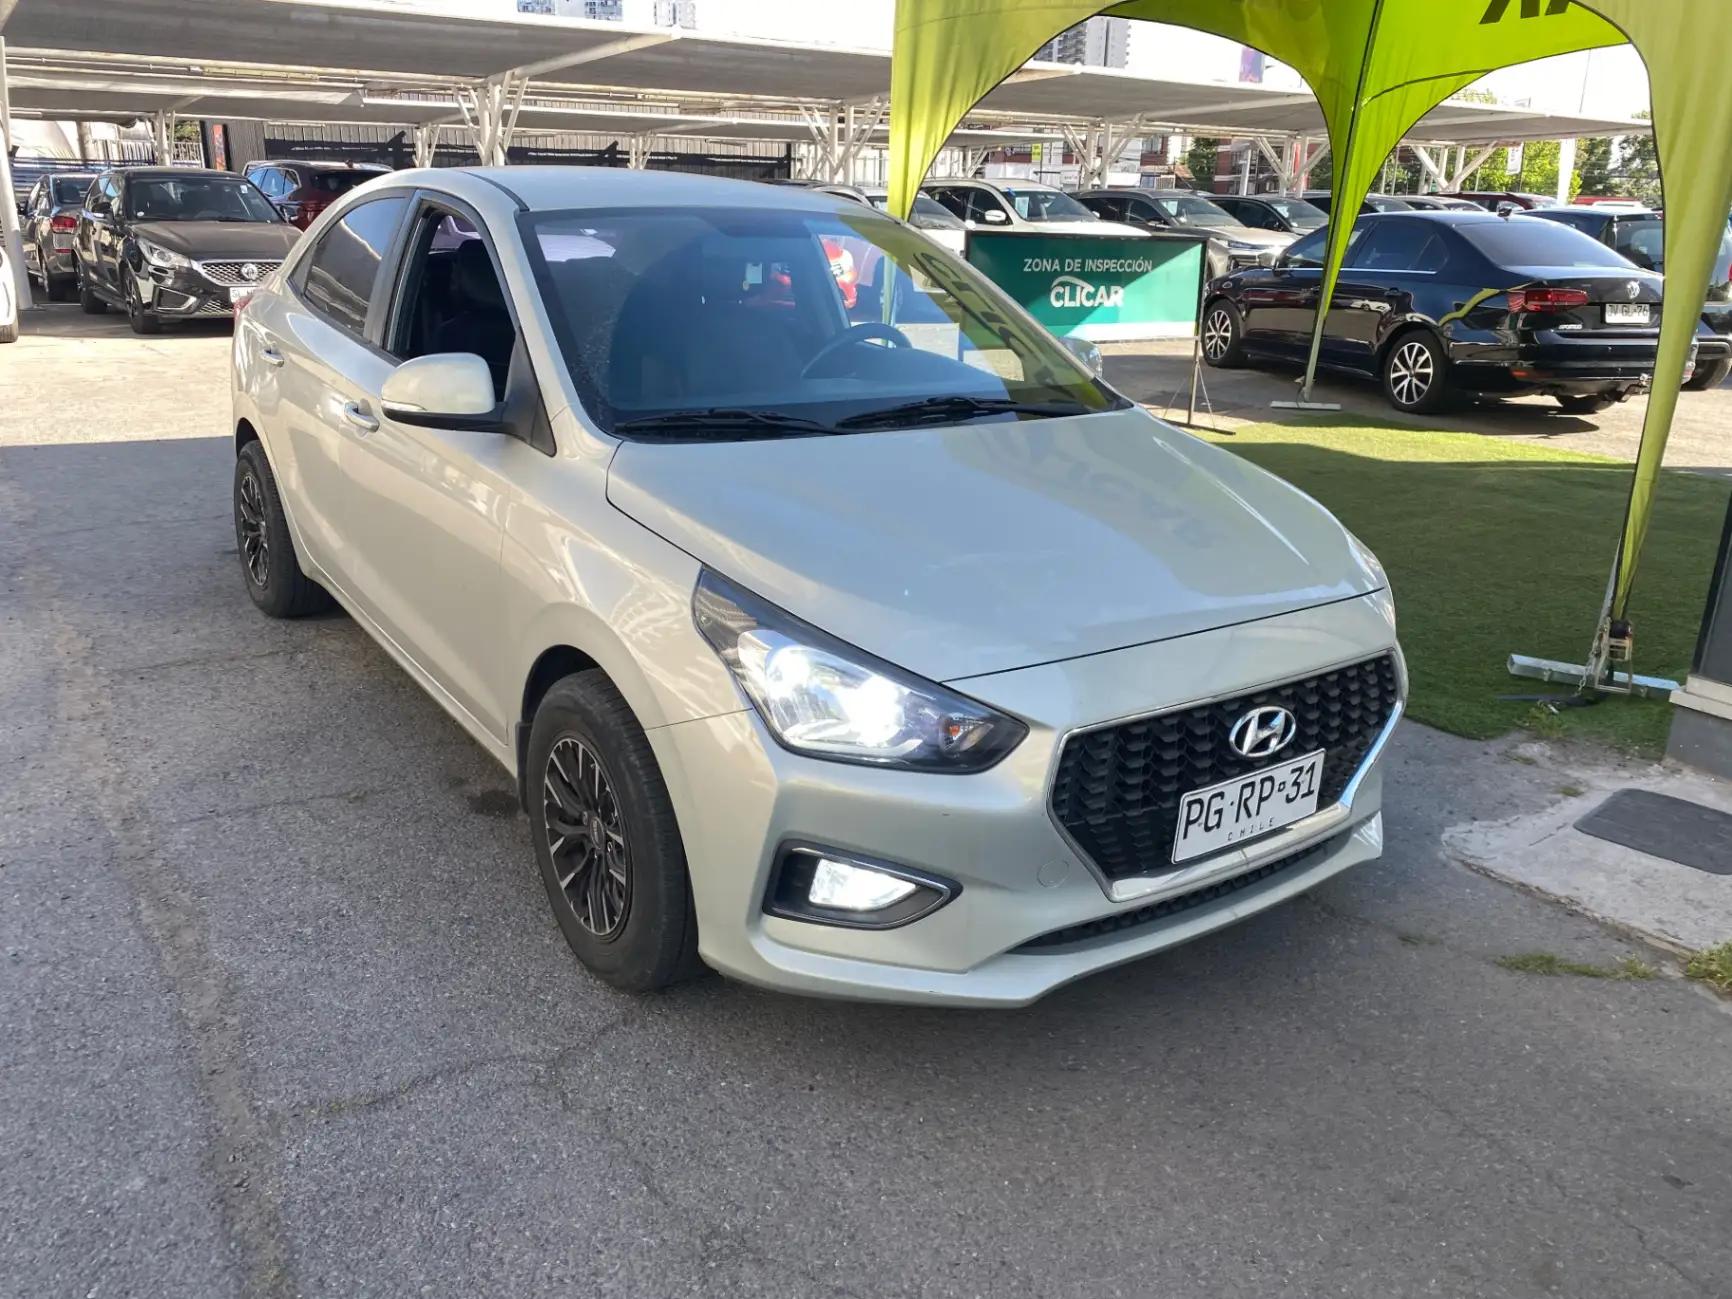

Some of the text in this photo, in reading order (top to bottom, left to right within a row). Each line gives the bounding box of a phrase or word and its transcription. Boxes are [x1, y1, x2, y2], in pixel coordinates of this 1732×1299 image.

[1023, 256, 1152, 273] ZONA DE INSPECCIÓN
[1050, 285, 1125, 308] CLICAR
[1227, 817, 1275, 841] CHILE
